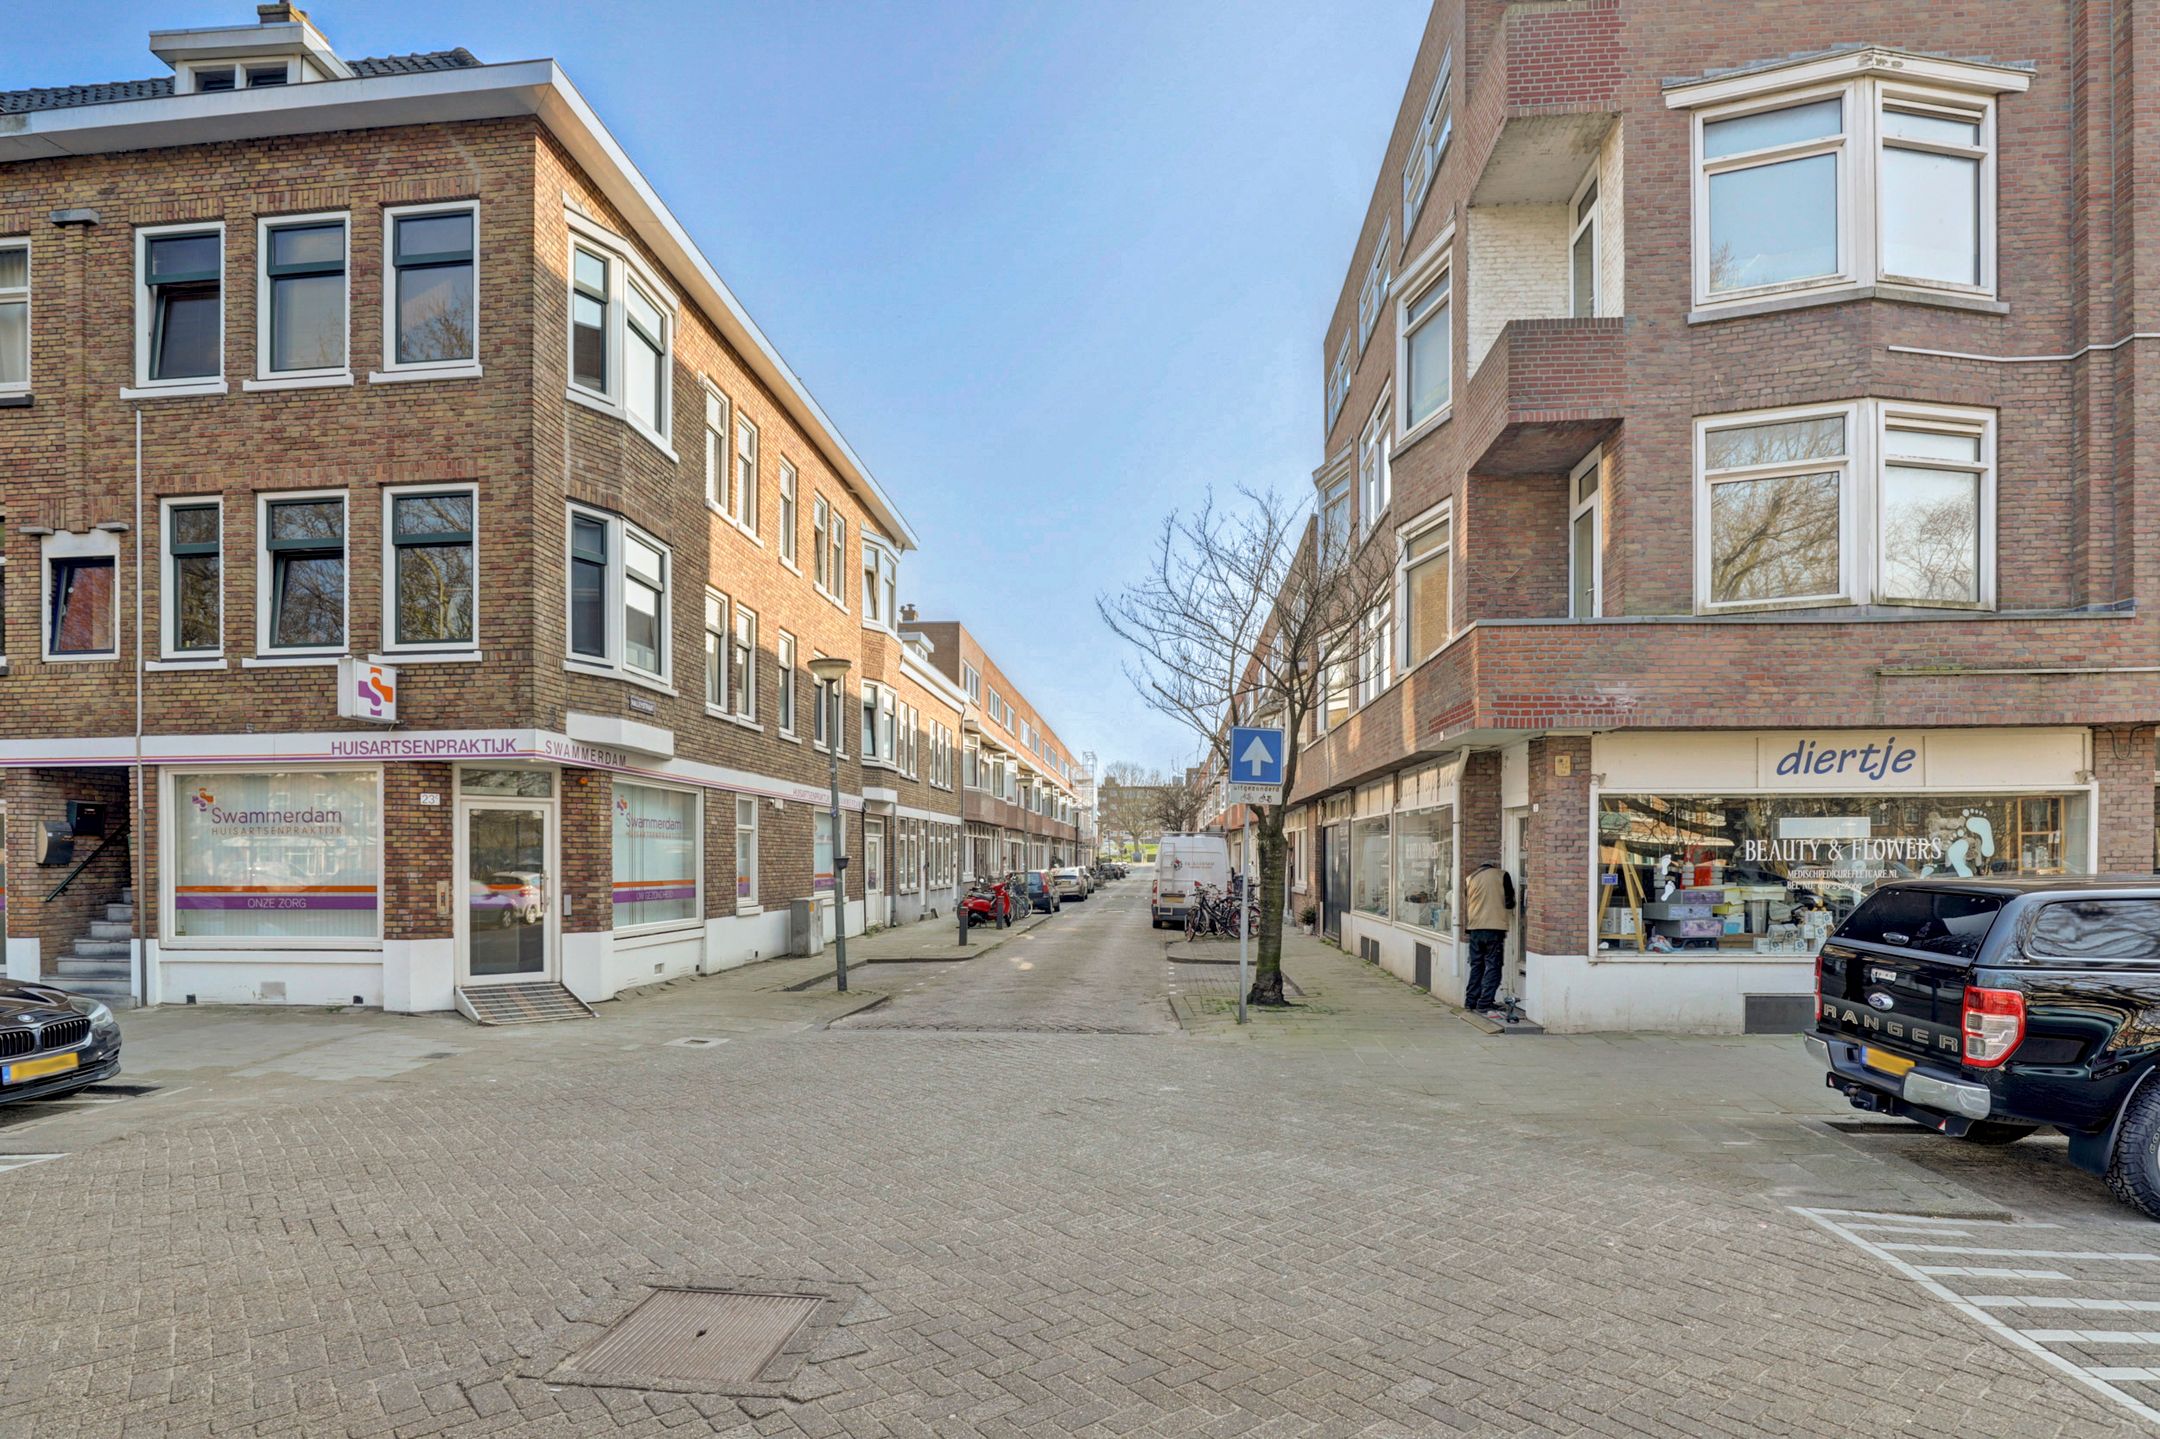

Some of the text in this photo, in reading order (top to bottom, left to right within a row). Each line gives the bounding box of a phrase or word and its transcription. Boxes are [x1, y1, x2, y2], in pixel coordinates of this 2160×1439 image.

[331, 738, 627, 768] HUISARTSENPRAKTIJK SWAMMERDAM
[1776, 736, 1917, 781] diertje
[1233, 785, 1280, 793] uitgezonderd
[211, 806, 343, 824] Swammerdam
[625, 812, 682, 830] Swammerdam
[211, 826, 343, 835] HUISARTSENPRAKTIJK
[1744, 837, 1942, 862] BEAUTY & FLOWERS
[247, 898, 307, 908] ONZE ZORG
[1823, 1003, 1959, 1053] RANGER
